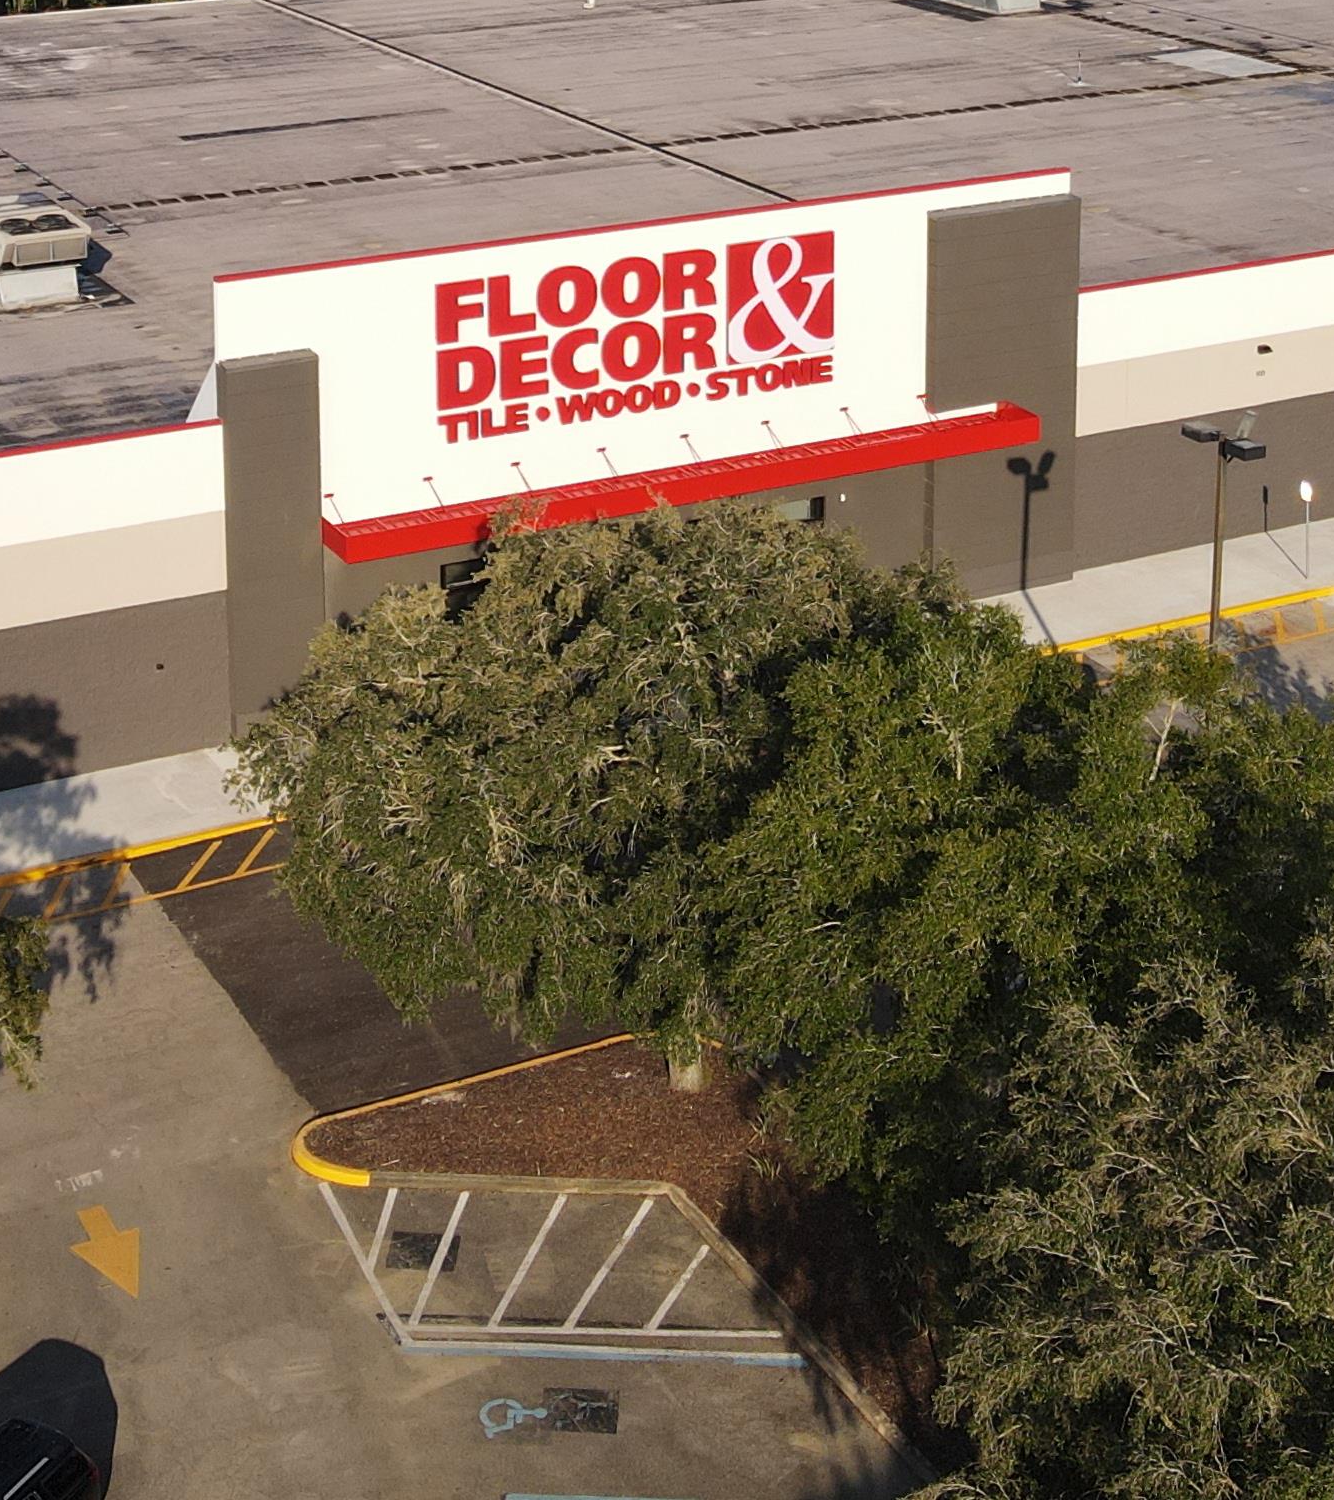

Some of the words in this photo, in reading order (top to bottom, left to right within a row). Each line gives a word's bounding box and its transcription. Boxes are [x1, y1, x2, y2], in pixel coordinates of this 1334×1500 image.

[434, 248, 718, 345] FLOOR
[727, 233, 835, 365] &
[435, 312, 718, 411] DECOR
[436, 402, 530, 444] TILE
[555, 379, 681, 425] WOOD
[705, 355, 834, 402] STONE
